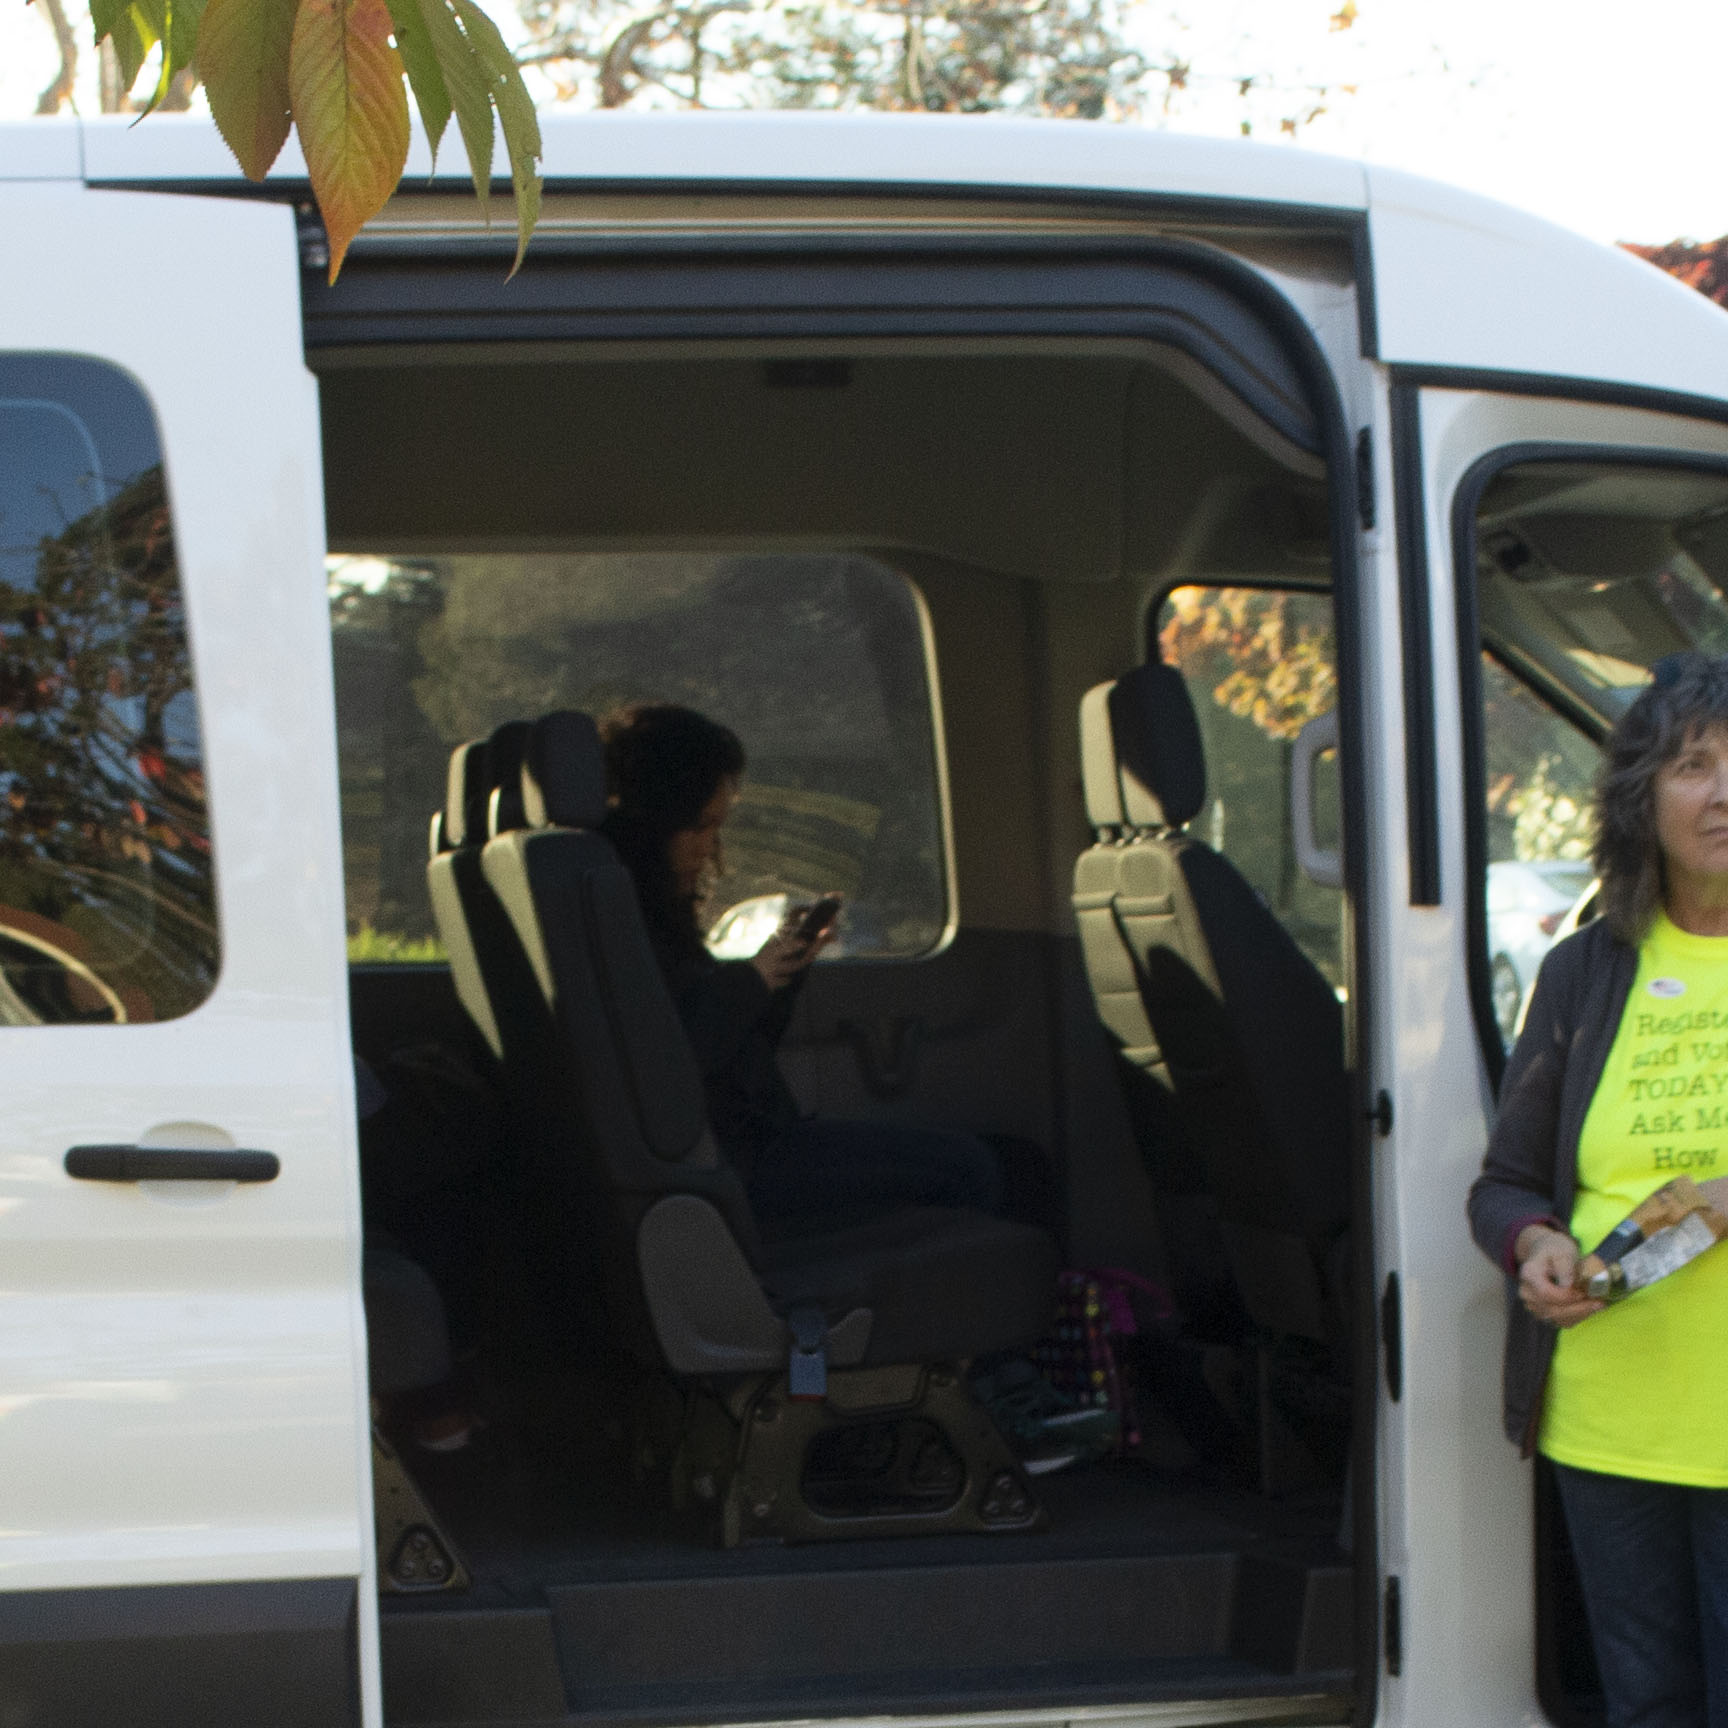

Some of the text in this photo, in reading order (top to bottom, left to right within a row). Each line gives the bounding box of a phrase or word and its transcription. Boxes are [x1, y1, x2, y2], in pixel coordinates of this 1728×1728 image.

[1632, 1043, 1679, 1069] and
[1630, 1111, 1685, 1135] Ask
[1653, 1147, 1718, 1170] How
